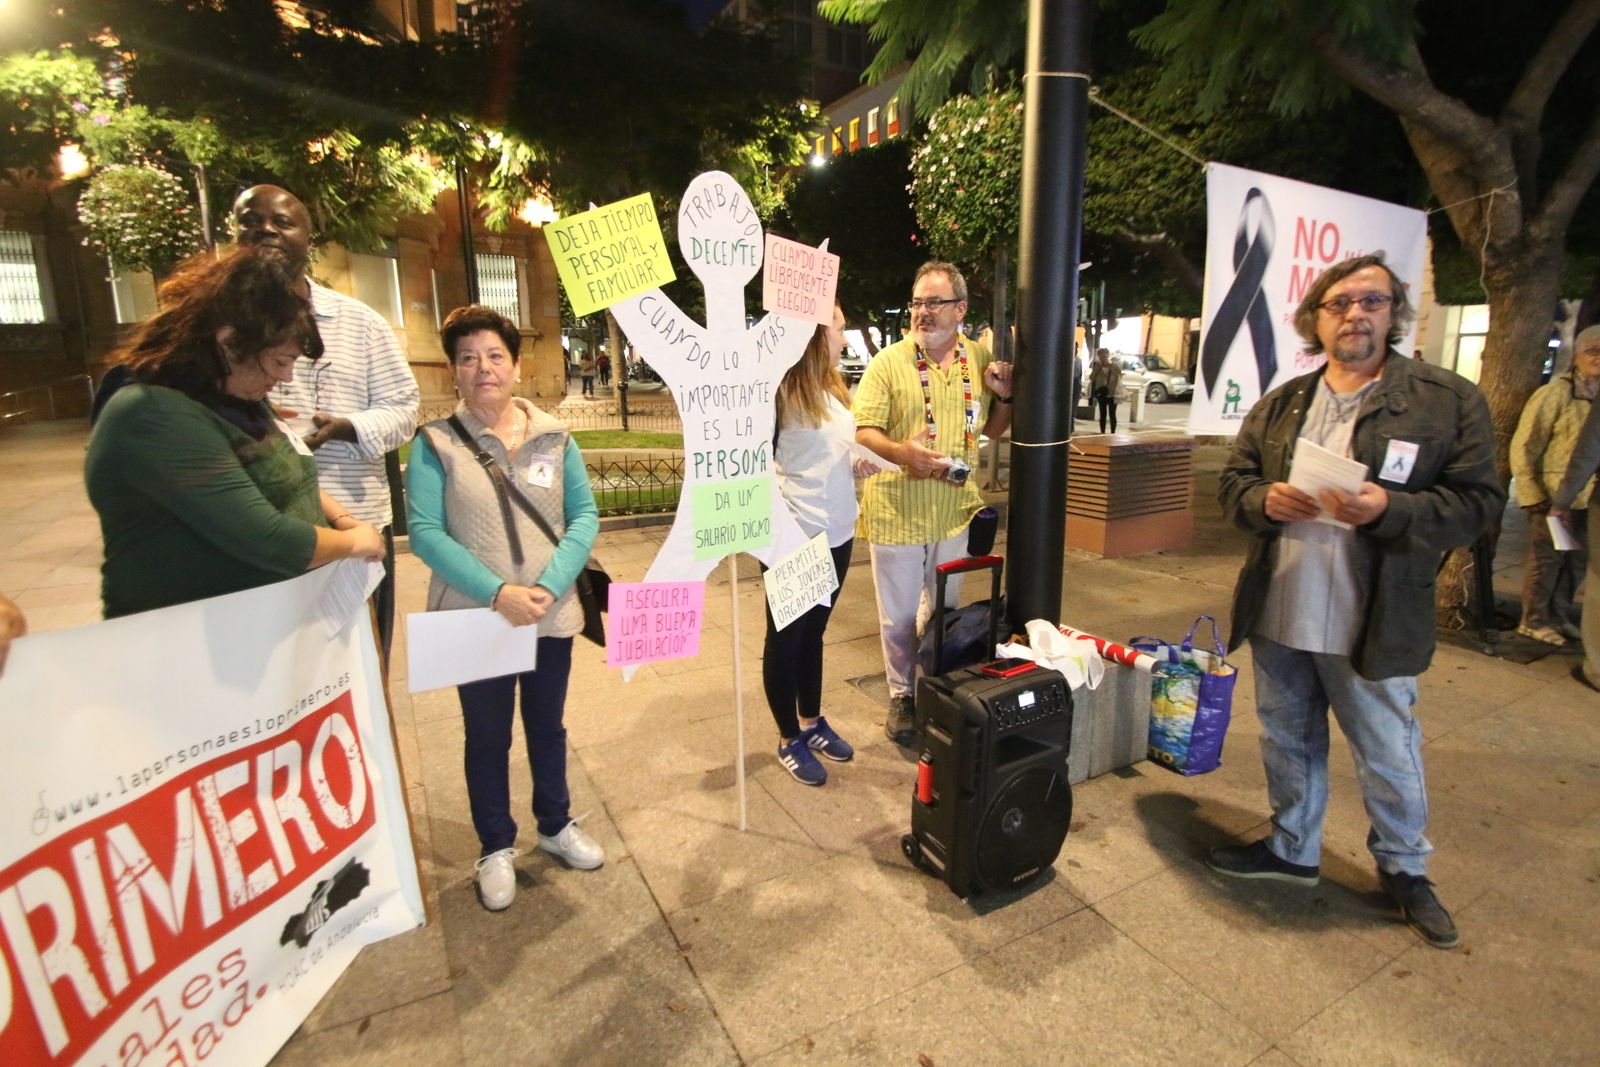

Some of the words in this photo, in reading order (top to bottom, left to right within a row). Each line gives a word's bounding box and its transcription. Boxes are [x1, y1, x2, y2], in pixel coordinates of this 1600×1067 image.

[554, 220, 602, 254] DEJA
[601, 202, 653, 236] TIEMPO
[683, 183, 759, 236] TRABAJO
[567, 235, 647, 280] PERSONAL
[690, 236, 758, 267] DECENTE
[770, 241, 816, 271] CUANDO
[820, 257, 835, 277] ES
[1293, 216, 1340, 264] NO
[587, 258, 660, 304] FAMILIAR
[769, 261, 829, 297] LIBREMENTE
[777, 288, 817, 316] ELEGIDO
[639, 296, 711, 370] CUANDO
[723, 351, 739, 371] LO
[756, 316, 786, 364] MÁS
[680, 379, 770, 414] IMPORTANTE
[703, 418, 721, 440] ES
[736, 416, 753, 437] LA
[693, 440, 768, 480] PERSONA
[715, 491, 731, 511] DA
[738, 484, 760, 507] UN
[695, 522, 737, 549] SALARIO
[742, 517, 770, 541] DIGNO
[775, 543, 820, 585] PERMITE
[625, 587, 689, 610] ASEGURA
[769, 594, 777, 610] A
[777, 582, 794, 604] LOS
[777, 571, 837, 624] ORGANIZARSE
[621, 613, 648, 637] UNA
[655, 610, 696, 633] BUENA
[54, 672, 351, 823] www.lapersonaesloprimero.es
[0, 711, 366, 1060] RIMERO
[101, 948, 247, 1067] ales
